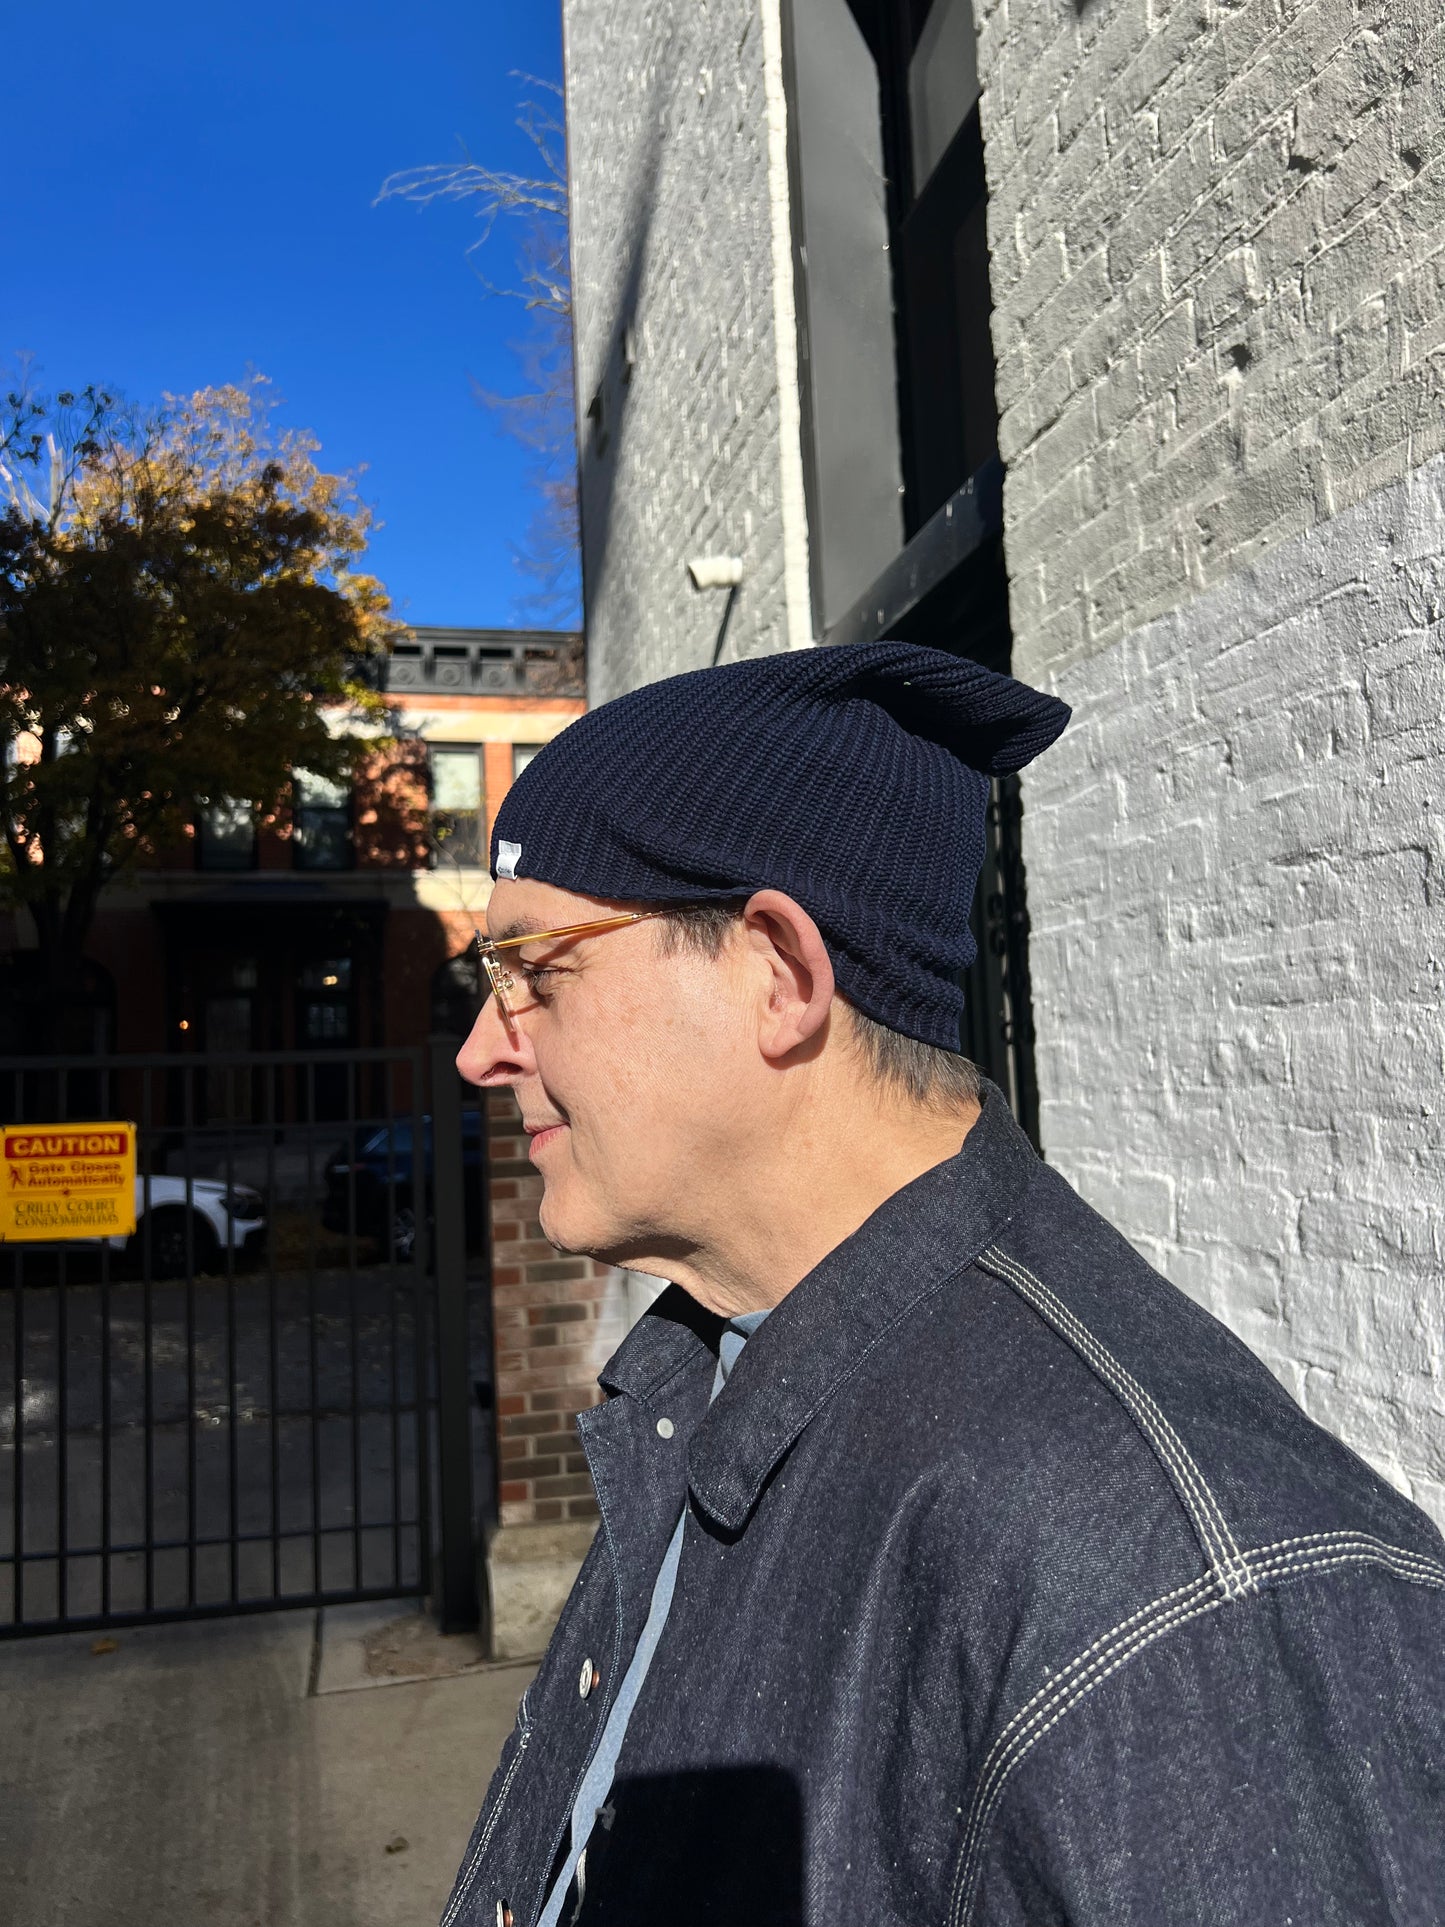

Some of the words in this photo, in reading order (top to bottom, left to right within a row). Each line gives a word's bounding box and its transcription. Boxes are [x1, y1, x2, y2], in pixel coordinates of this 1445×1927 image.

[13, 1135, 120, 1156] CAUTION
[28, 1162, 65, 1175] Gate
[71, 1161, 121, 1174] Closes
[28, 1174, 125, 1187] Automatically
[67, 1197, 116, 1212] COURT
